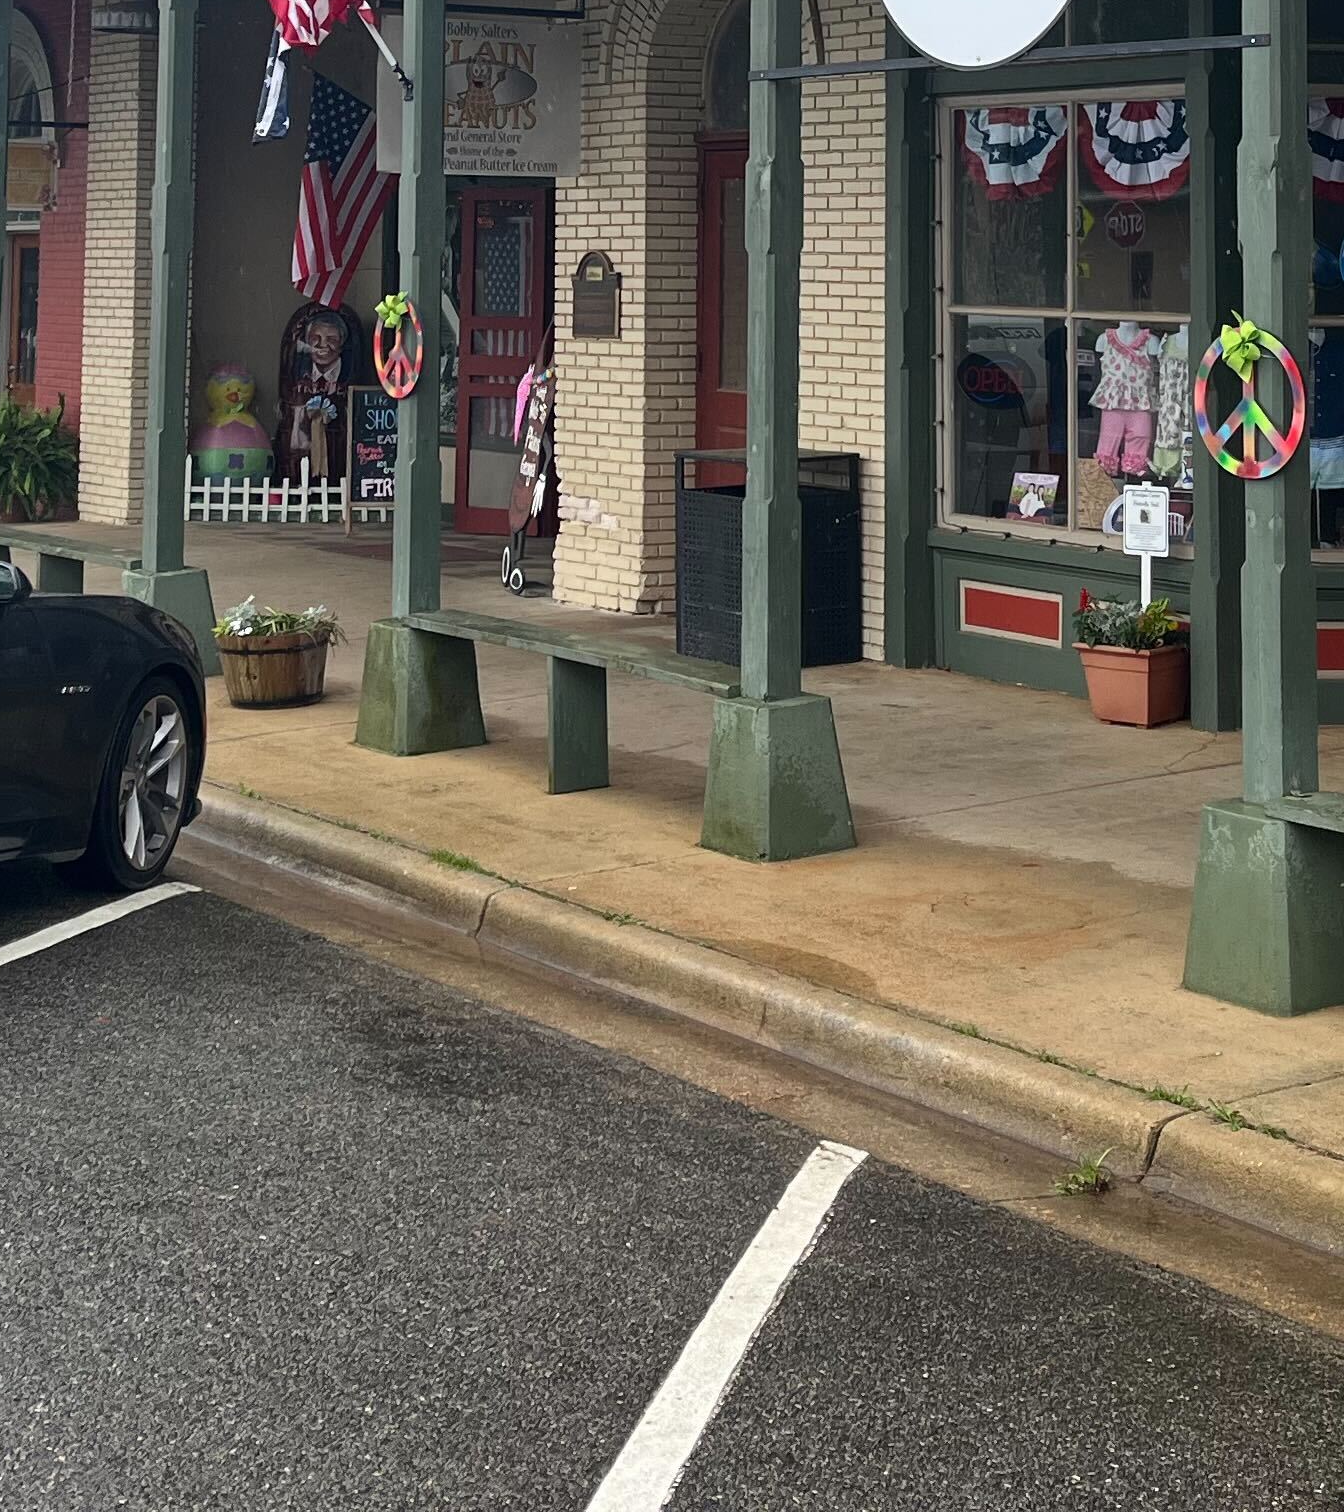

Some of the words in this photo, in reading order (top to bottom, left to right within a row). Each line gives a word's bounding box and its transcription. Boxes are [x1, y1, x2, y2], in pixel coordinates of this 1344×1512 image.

[447, 22, 479, 39] Bobby
[444, 39, 536, 73] LAIN
[444, 99, 536, 130] EANUTS
[444, 131, 459, 142] nd
[460, 131, 496, 142] General
[498, 131, 521, 144] Store
[444, 158, 478, 170] Peanut
[480, 159, 512, 171] Butter
[513, 160, 526, 171] Ice
[527, 160, 558, 172] Cream
[963, 366, 1025, 393] OPEN
[365, 409, 398, 430] SHO
[361, 478, 395, 498] FIR
